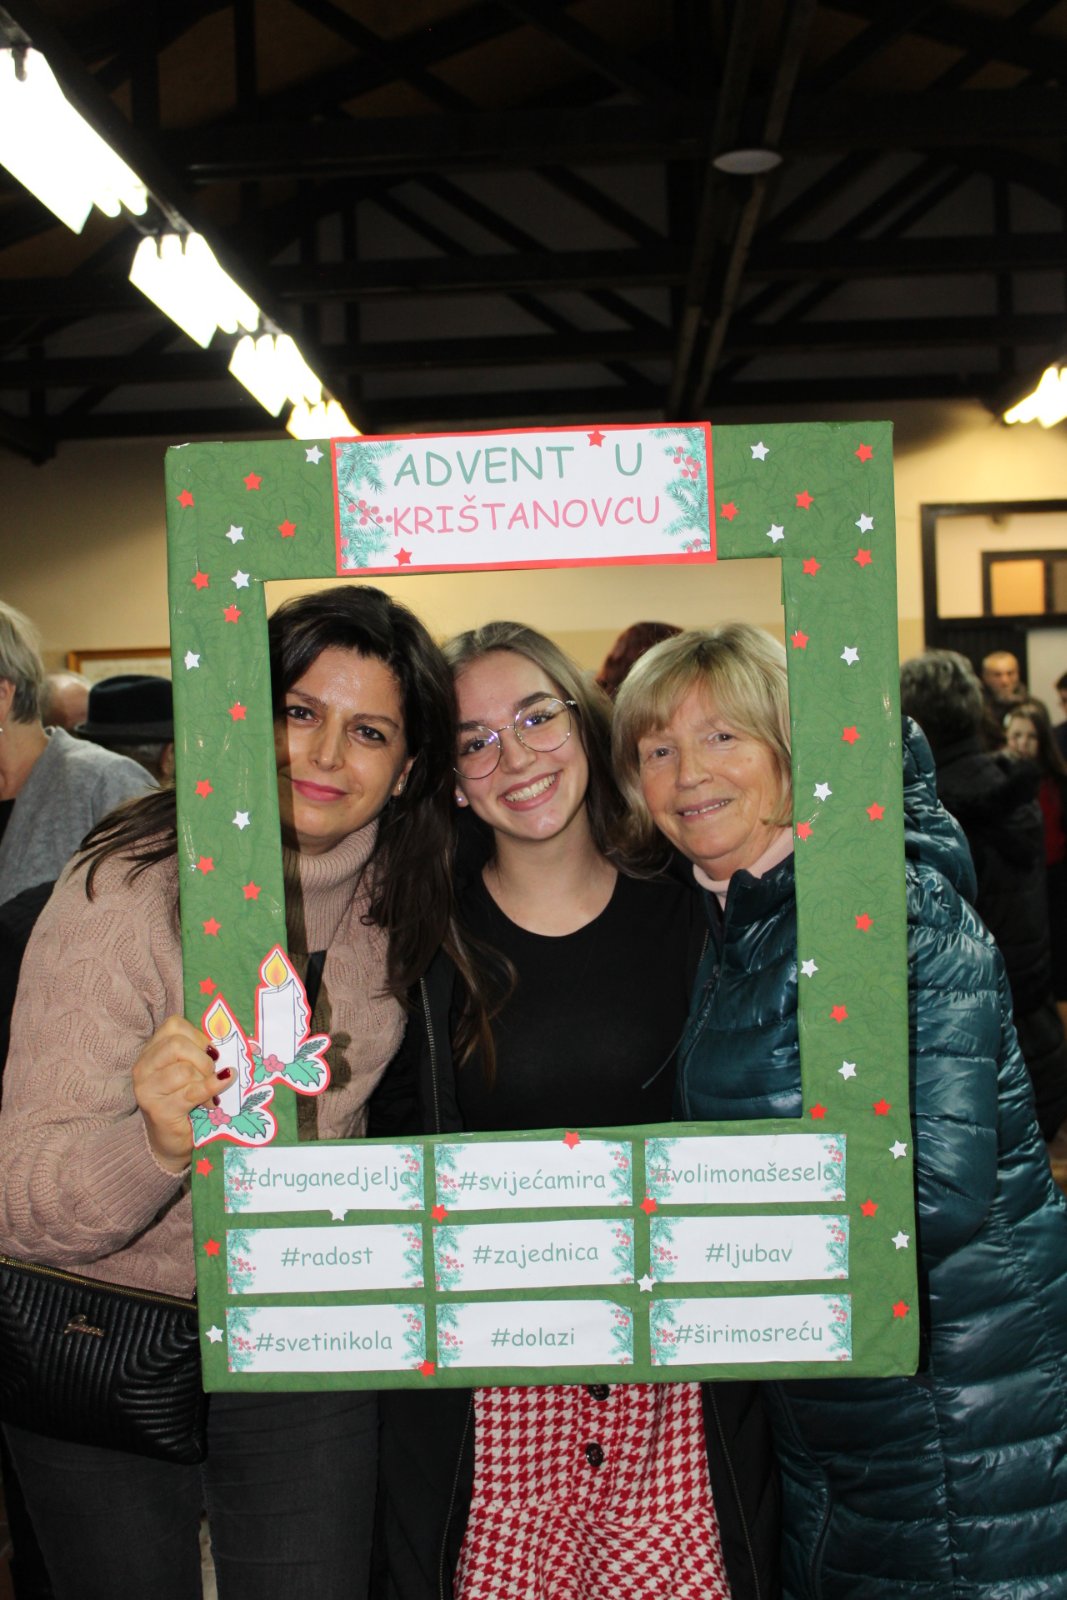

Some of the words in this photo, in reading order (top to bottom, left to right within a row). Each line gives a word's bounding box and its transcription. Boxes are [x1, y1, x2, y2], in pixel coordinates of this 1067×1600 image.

[393, 445, 575, 487] ADVENT
[614, 442, 643, 477] U
[393, 494, 660, 537] KRIŠTANOVCU
[459, 1168, 606, 1197] #svijećamira
[653, 1161, 836, 1184] #volimonašeselo
[280, 1245, 374, 1267] #radost
[472, 1242, 599, 1269] #zajednica
[705, 1242, 793, 1269] #ljubav
[255, 1330, 393, 1352] #svetinikola
[490, 1327, 575, 1348] #dolazi
[674, 1319, 823, 1345] #širimosreću
